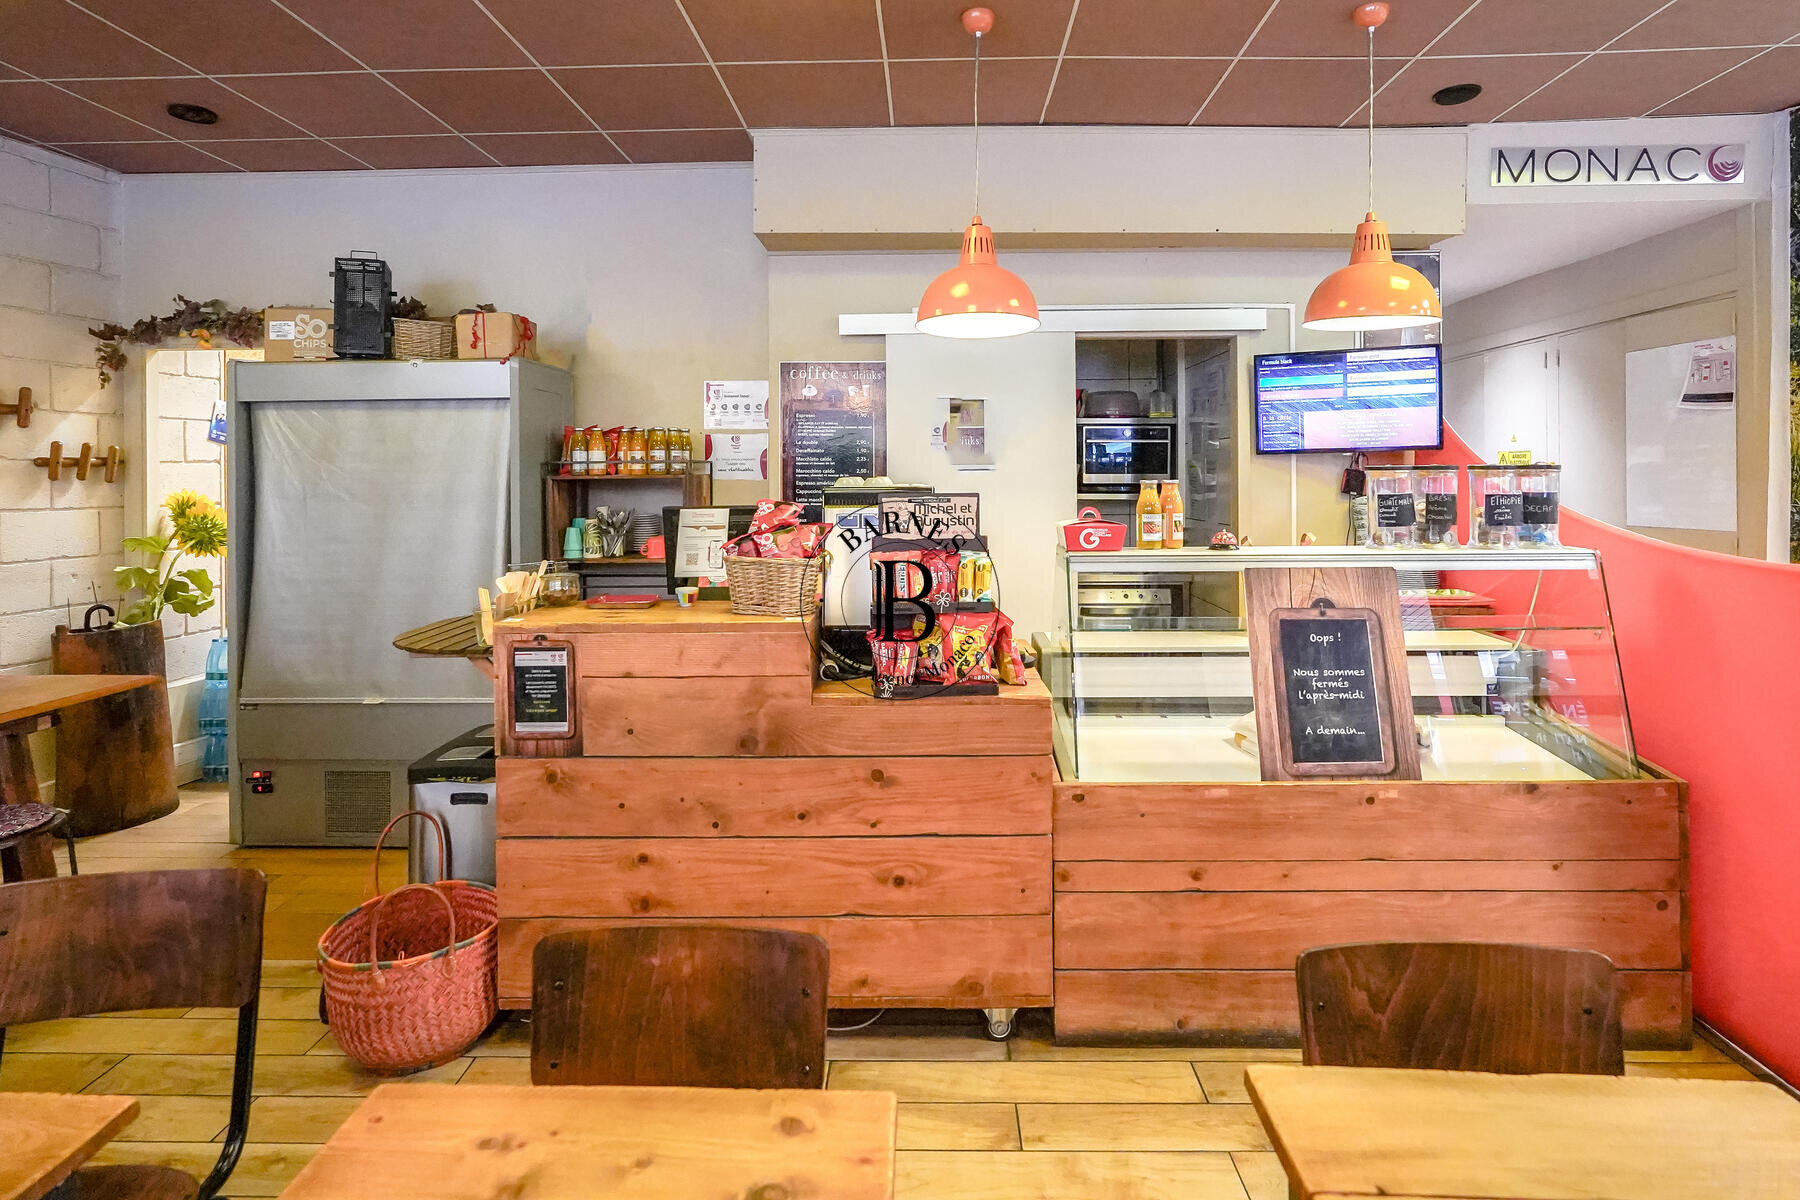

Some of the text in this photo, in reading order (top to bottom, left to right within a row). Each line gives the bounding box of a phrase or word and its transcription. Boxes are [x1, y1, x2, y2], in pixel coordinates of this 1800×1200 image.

[790, 365, 839, 380] coffee
[852, 370, 882, 380] drinks
[960, 504, 972, 514] et
[1309, 632, 1342, 647] Oops !
[1293, 668, 1365, 677] Nous sommes
[1311, 677, 1349, 690] fermés
[1298, 689, 1365, 705] l'après-midi
[1305, 725, 1366, 736] A demain...
